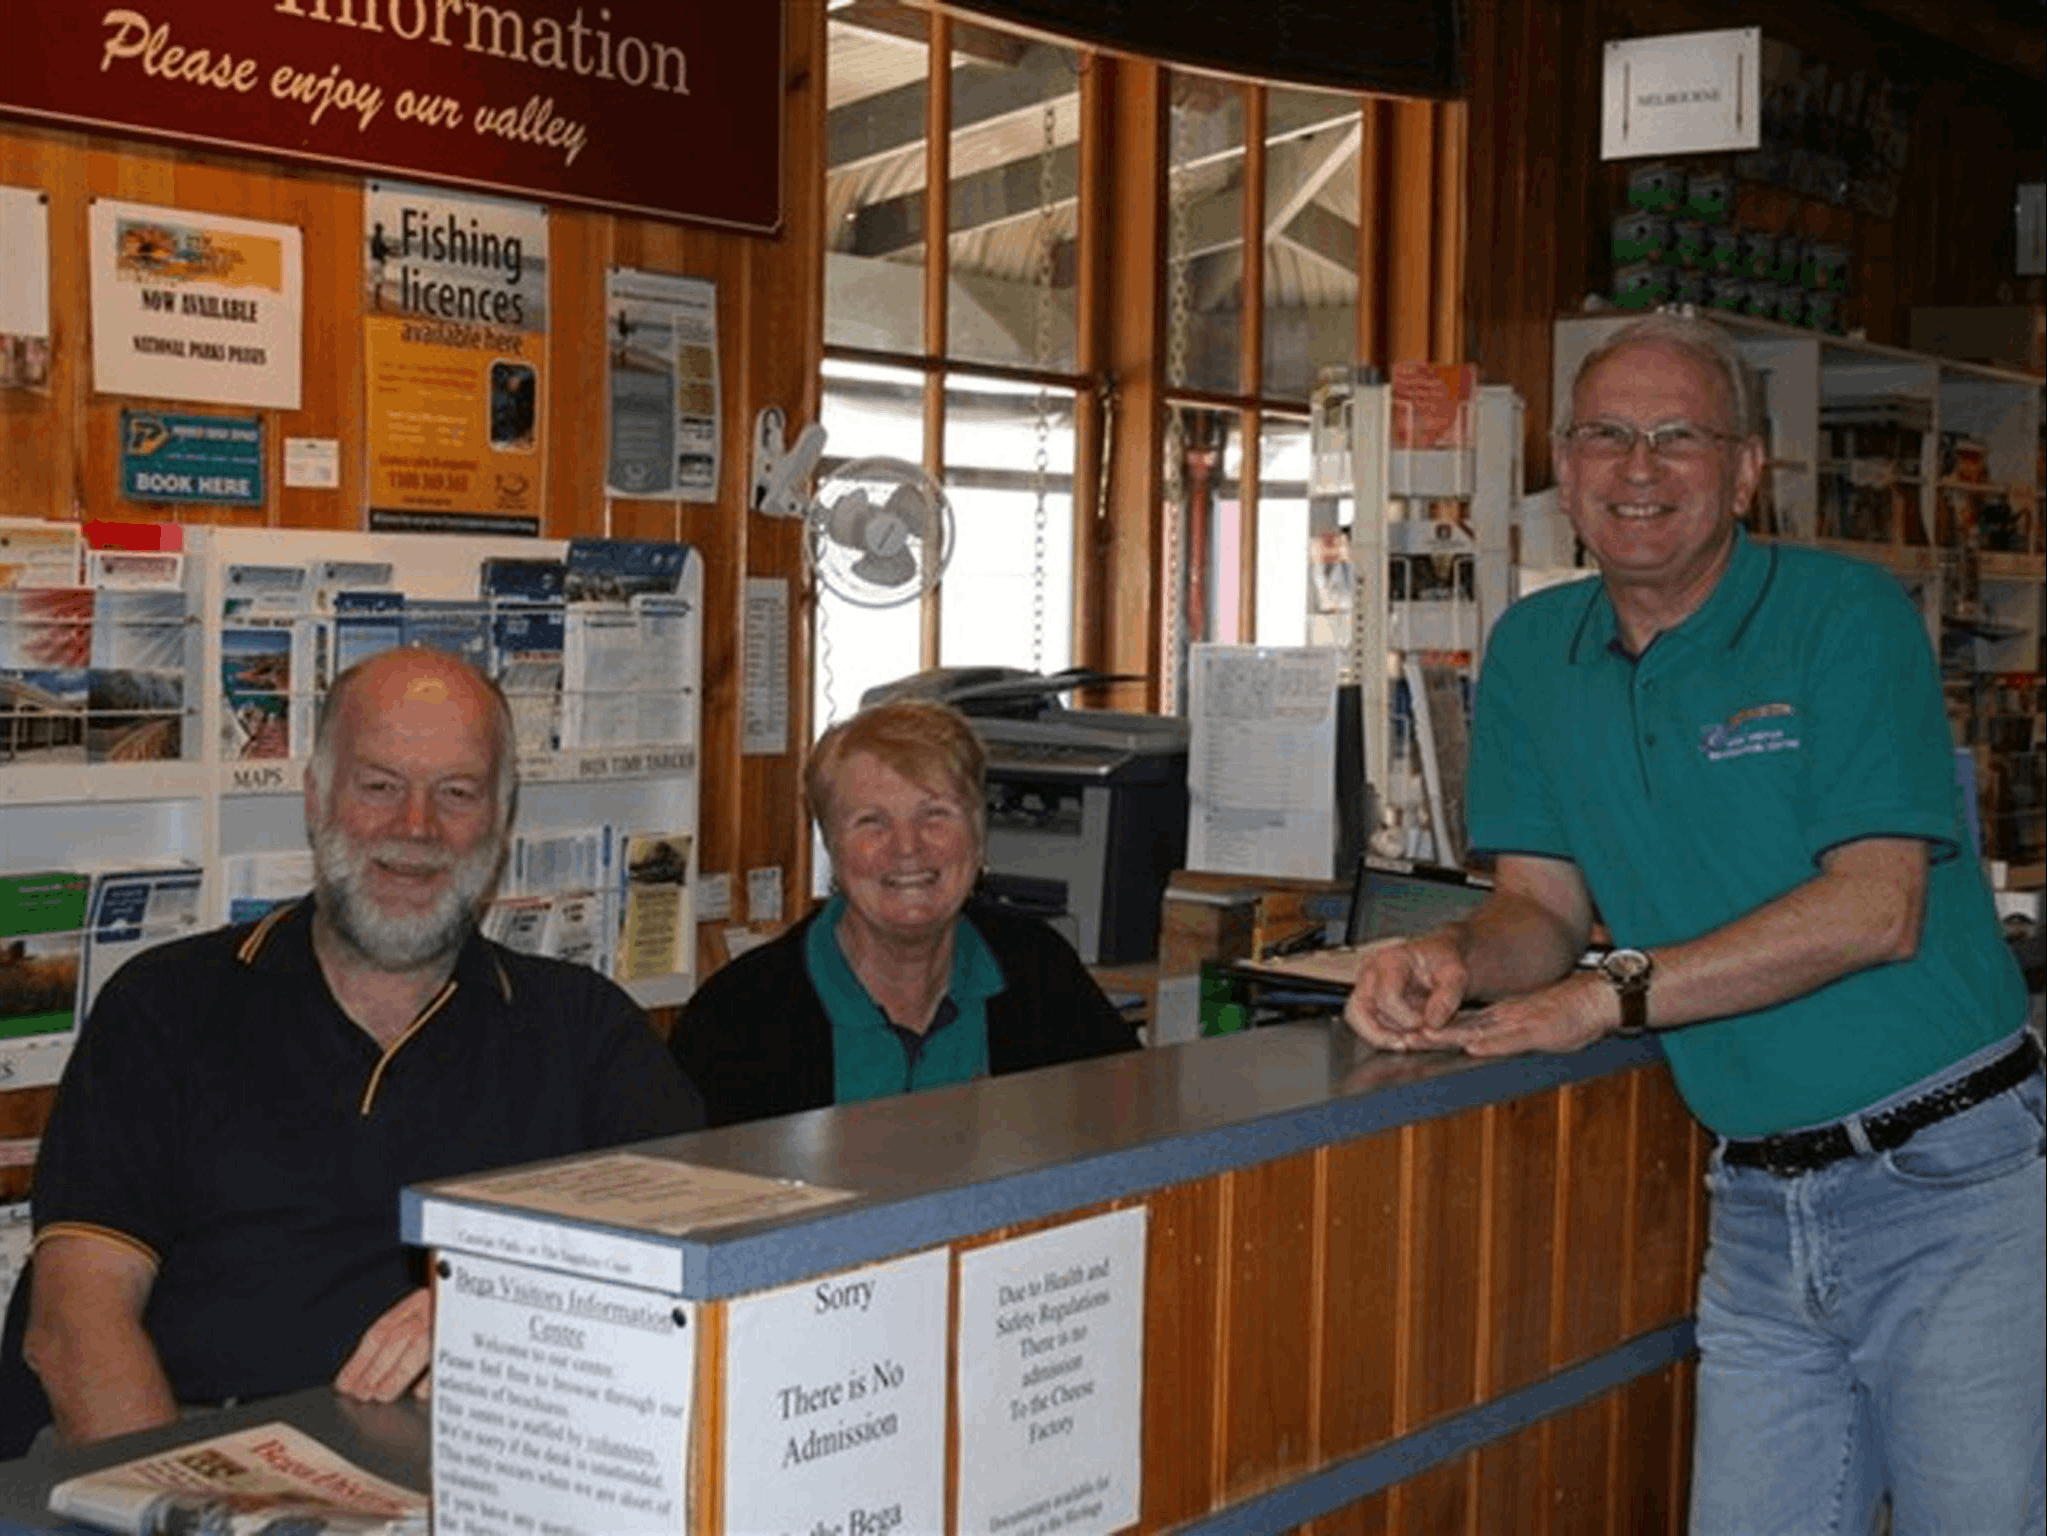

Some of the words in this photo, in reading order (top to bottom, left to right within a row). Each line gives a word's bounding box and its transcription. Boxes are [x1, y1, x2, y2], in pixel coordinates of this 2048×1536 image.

[274, 0, 691, 95] ormation
[101, 10, 258, 93] Please
[271, 64, 384, 133] enjoy
[394, 89, 464, 129] our
[474, 95, 588, 166] valley
[402, 207, 523, 286] Fishing
[141, 288, 176, 314] NOW
[181, 293, 258, 324] AVAILABLE
[401, 265, 524, 327] licences
[402, 321, 480, 350] available
[485, 325, 524, 356] here
[136, 472, 192, 493] BOOK
[198, 476, 251, 497] HERE
[233, 768, 284, 788] MAPS
[813, 1277, 876, 1315] Sorry
[999, 1283, 1026, 1306] Due
[1043, 1265, 1085, 1293] Health
[1088, 1256, 1111, 1281] and
[499, 1275, 563, 1311] Visitors
[567, 1289, 674, 1334] Information
[996, 1311, 1036, 1338] Safety
[1039, 1291, 1111, 1324] Regulations
[1020, 1336, 1056, 1358] There
[777, 1379, 845, 1420] There
[847, 1373, 867, 1402] is
[871, 1358, 906, 1396] No
[1022, 1354, 1084, 1387] admission
[1009, 1399, 1028, 1422] To
[1050, 1381, 1096, 1407] Cheese
[781, 1409, 899, 1470] Admission
[1028, 1416, 1075, 1445] Factory
[810, 1520, 843, 1536] he
[849, 1502, 902, 1536] Bega
